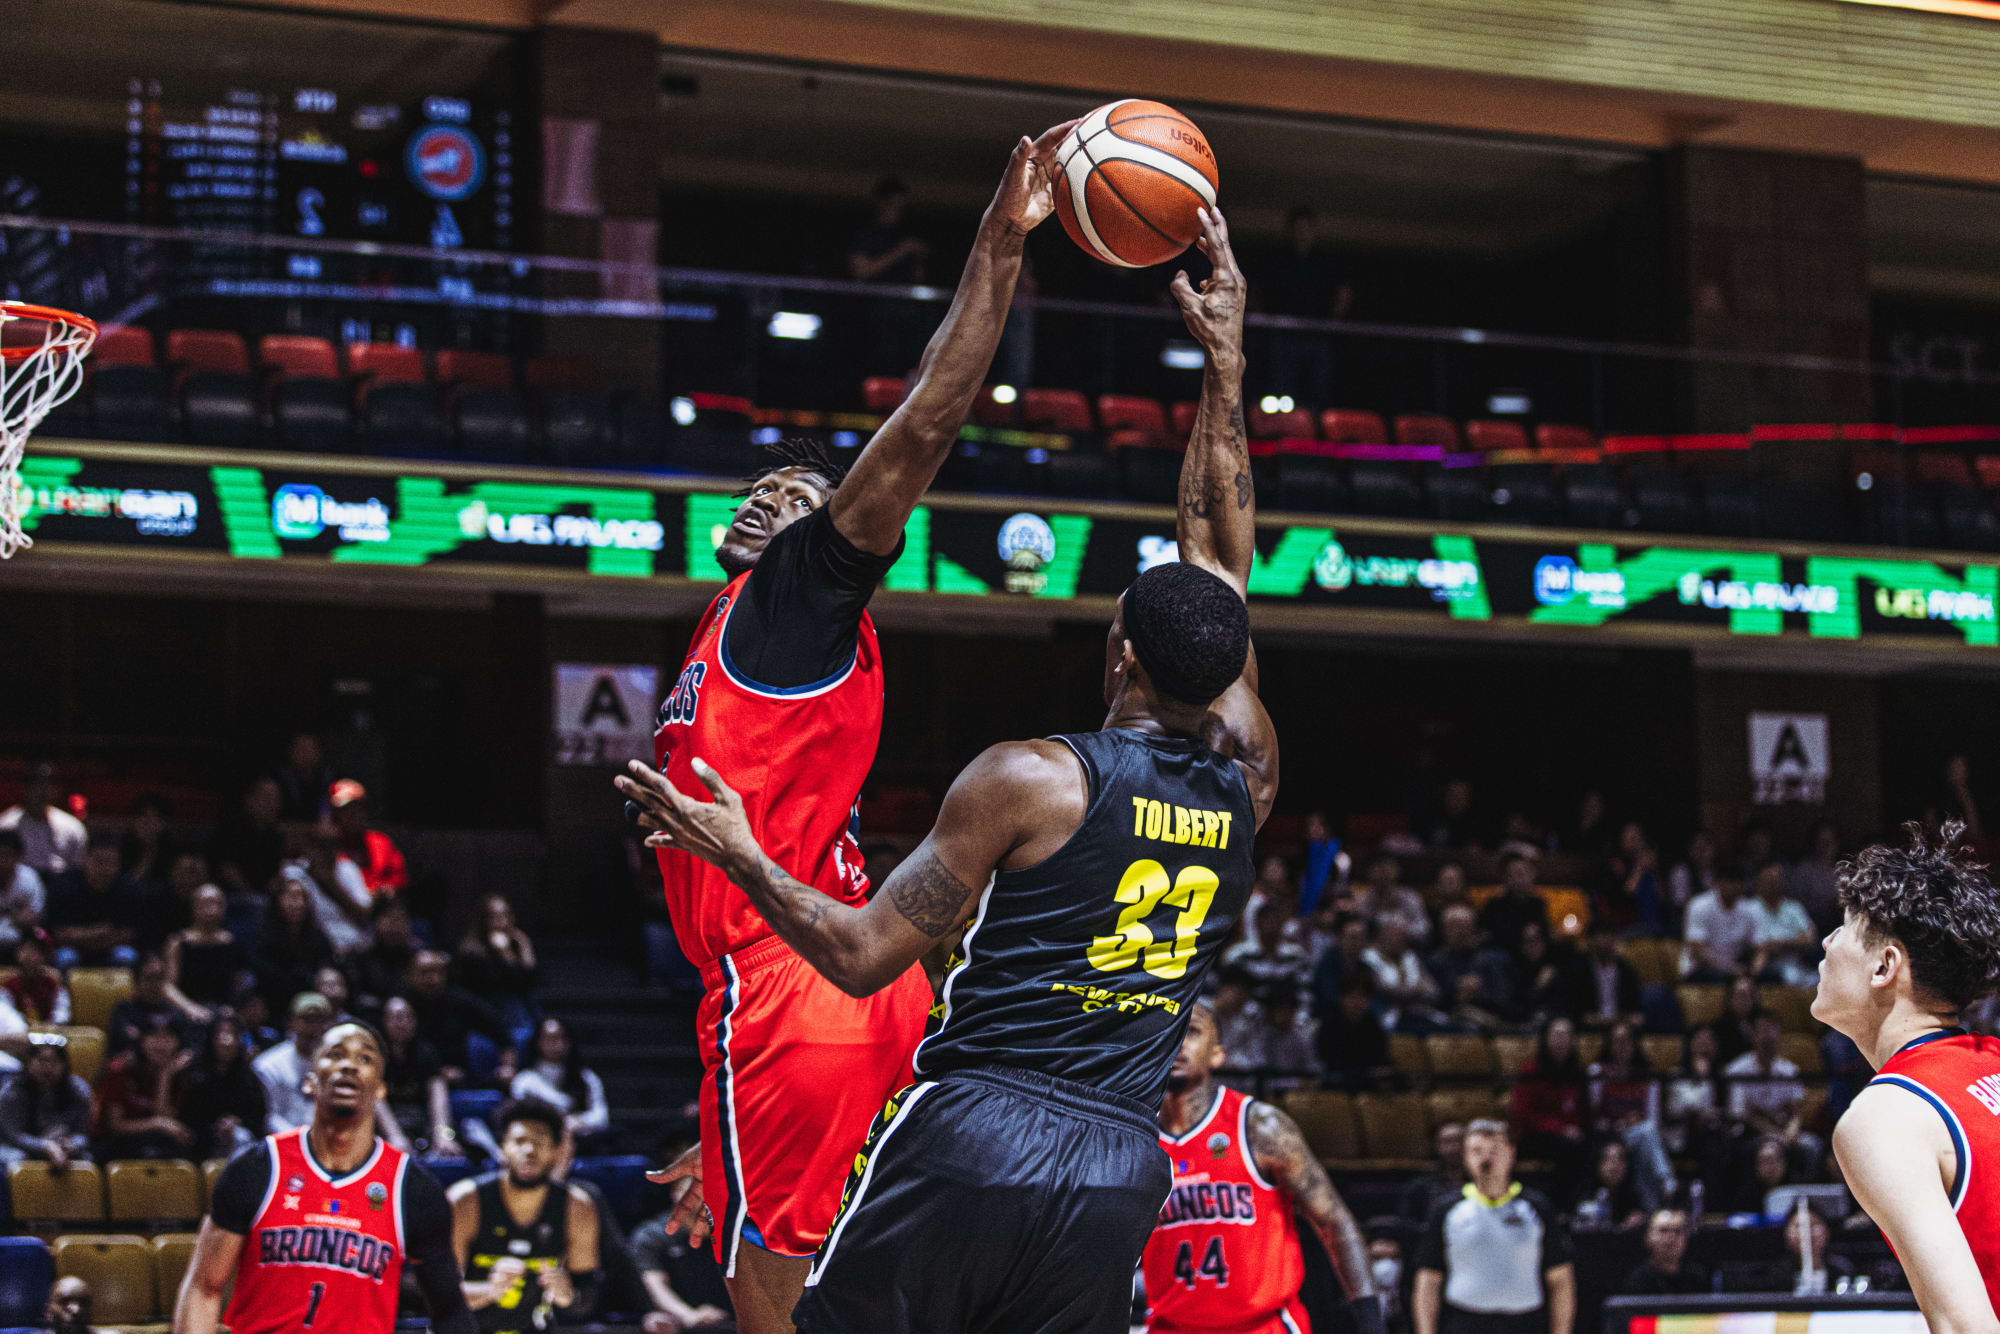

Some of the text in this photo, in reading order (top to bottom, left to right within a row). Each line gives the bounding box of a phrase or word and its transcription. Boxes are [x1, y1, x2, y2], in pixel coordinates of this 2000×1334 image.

[581, 676, 631, 727] A
[1771, 722, 1811, 769] A
[1132, 796, 1233, 850] TOLBERT
[1086, 858, 1220, 979] 33
[1081, 1000, 1144, 1014] CTY
[259, 1225, 396, 1285] BRONCOS
[1173, 1235, 1230, 1291] 44
[303, 1281, 327, 1329] 1
